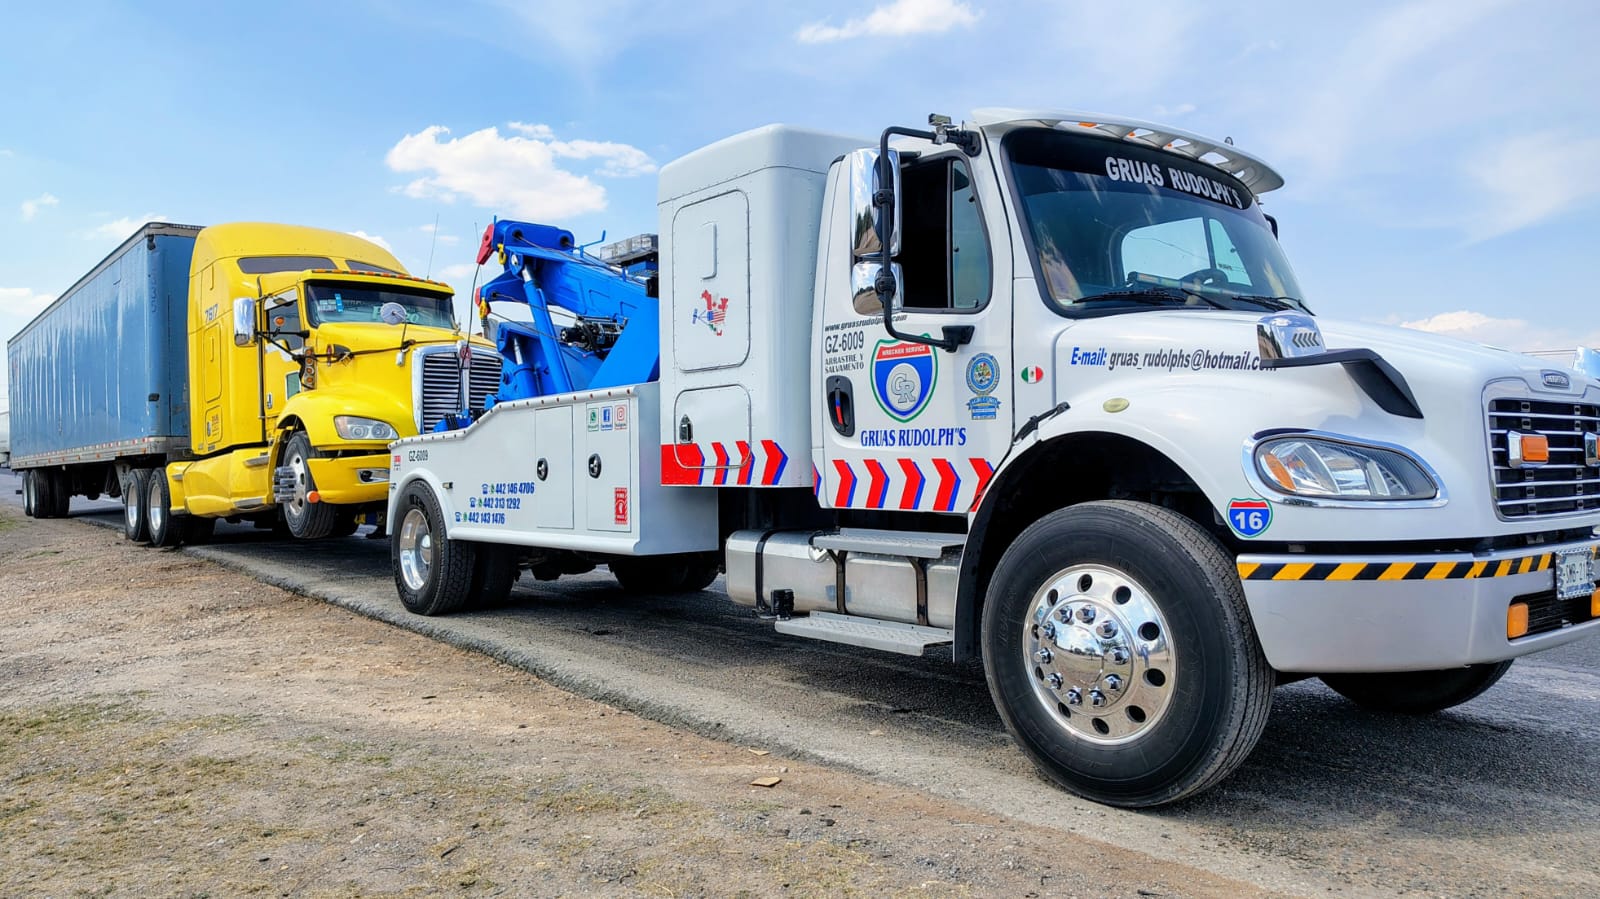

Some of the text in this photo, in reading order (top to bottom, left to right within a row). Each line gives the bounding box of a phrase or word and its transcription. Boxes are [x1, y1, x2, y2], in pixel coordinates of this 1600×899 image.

[1105, 156, 1165, 187] GRUAS
[825, 330, 865, 354] GZ-6009
[1070, 347, 1277, 371] E-mail: gruas_rudolphs@hotmail.c
[860, 430, 896, 447] GRUAS
[495, 483, 506, 495] 442
[483, 497, 494, 509] 442
[506, 498, 521, 510] 1292
[468, 511, 505, 525] 442 143 1476
[1235, 511, 1263, 530] 16
